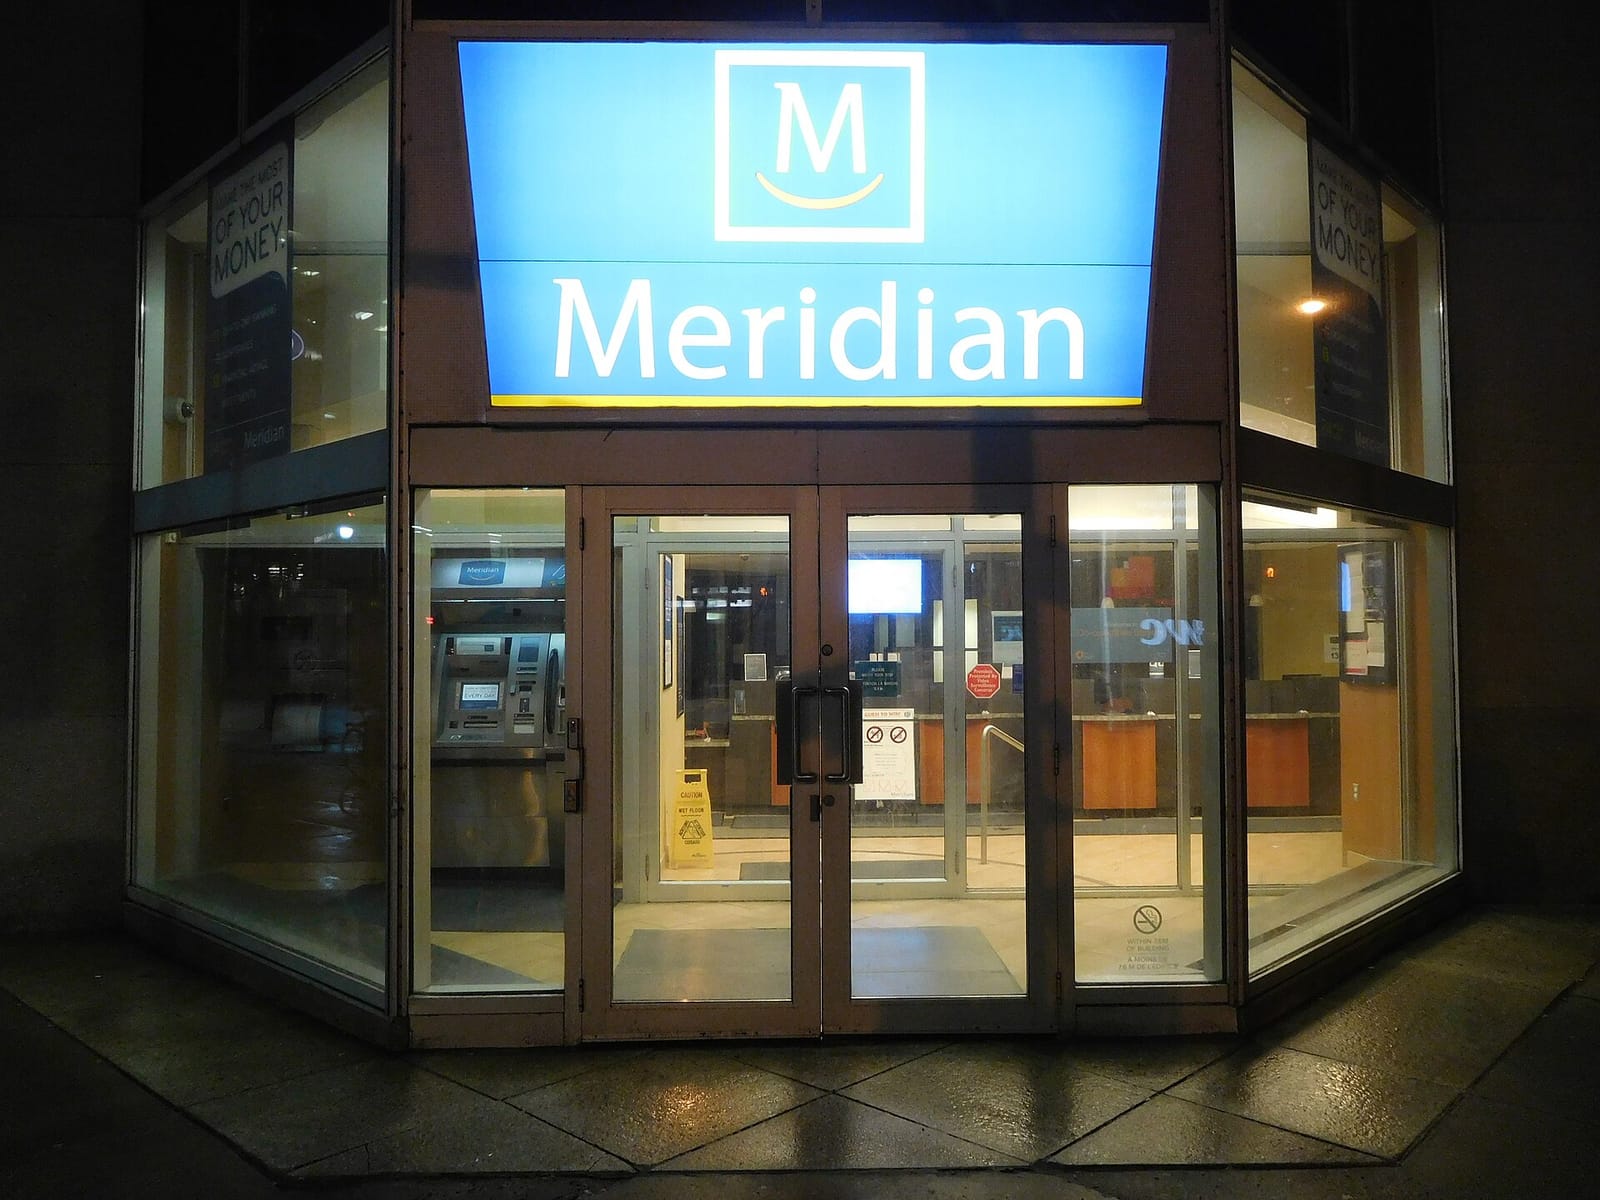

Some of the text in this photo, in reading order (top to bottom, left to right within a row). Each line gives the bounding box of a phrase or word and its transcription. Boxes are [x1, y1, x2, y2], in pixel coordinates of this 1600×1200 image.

[773, 81, 867, 173] M
[216, 180, 284, 245] OF YOUR
[1318, 181, 1337, 215] OF
[1340, 194, 1377, 239] YOUR
[214, 214, 286, 285] MONEY.
[552, 277, 1085, 382] Meridian
[243, 423, 286, 449] Meridian
[680, 791, 703, 799] CAUTION
